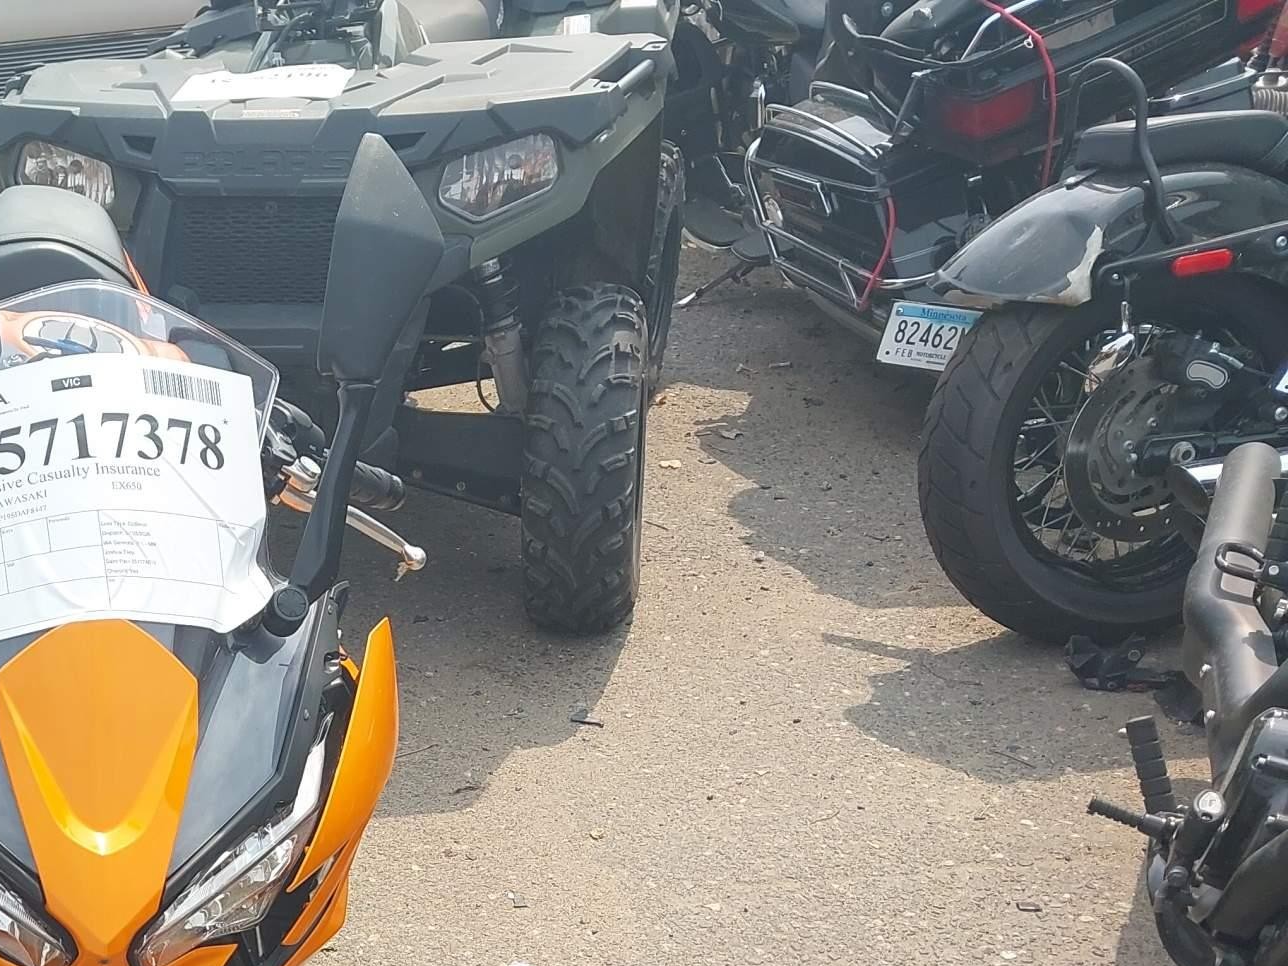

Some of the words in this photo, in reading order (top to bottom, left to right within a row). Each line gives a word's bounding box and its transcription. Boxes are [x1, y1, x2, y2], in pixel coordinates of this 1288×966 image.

[920, 308, 967, 321] Minnesota
[895, 348, 914, 358] FEB
[62, 377, 81, 388] VIC
[27, 464, 90, 485] Casualty
[95, 462, 161, 477] Insurance
[112, 481, 143, 491] EX650
